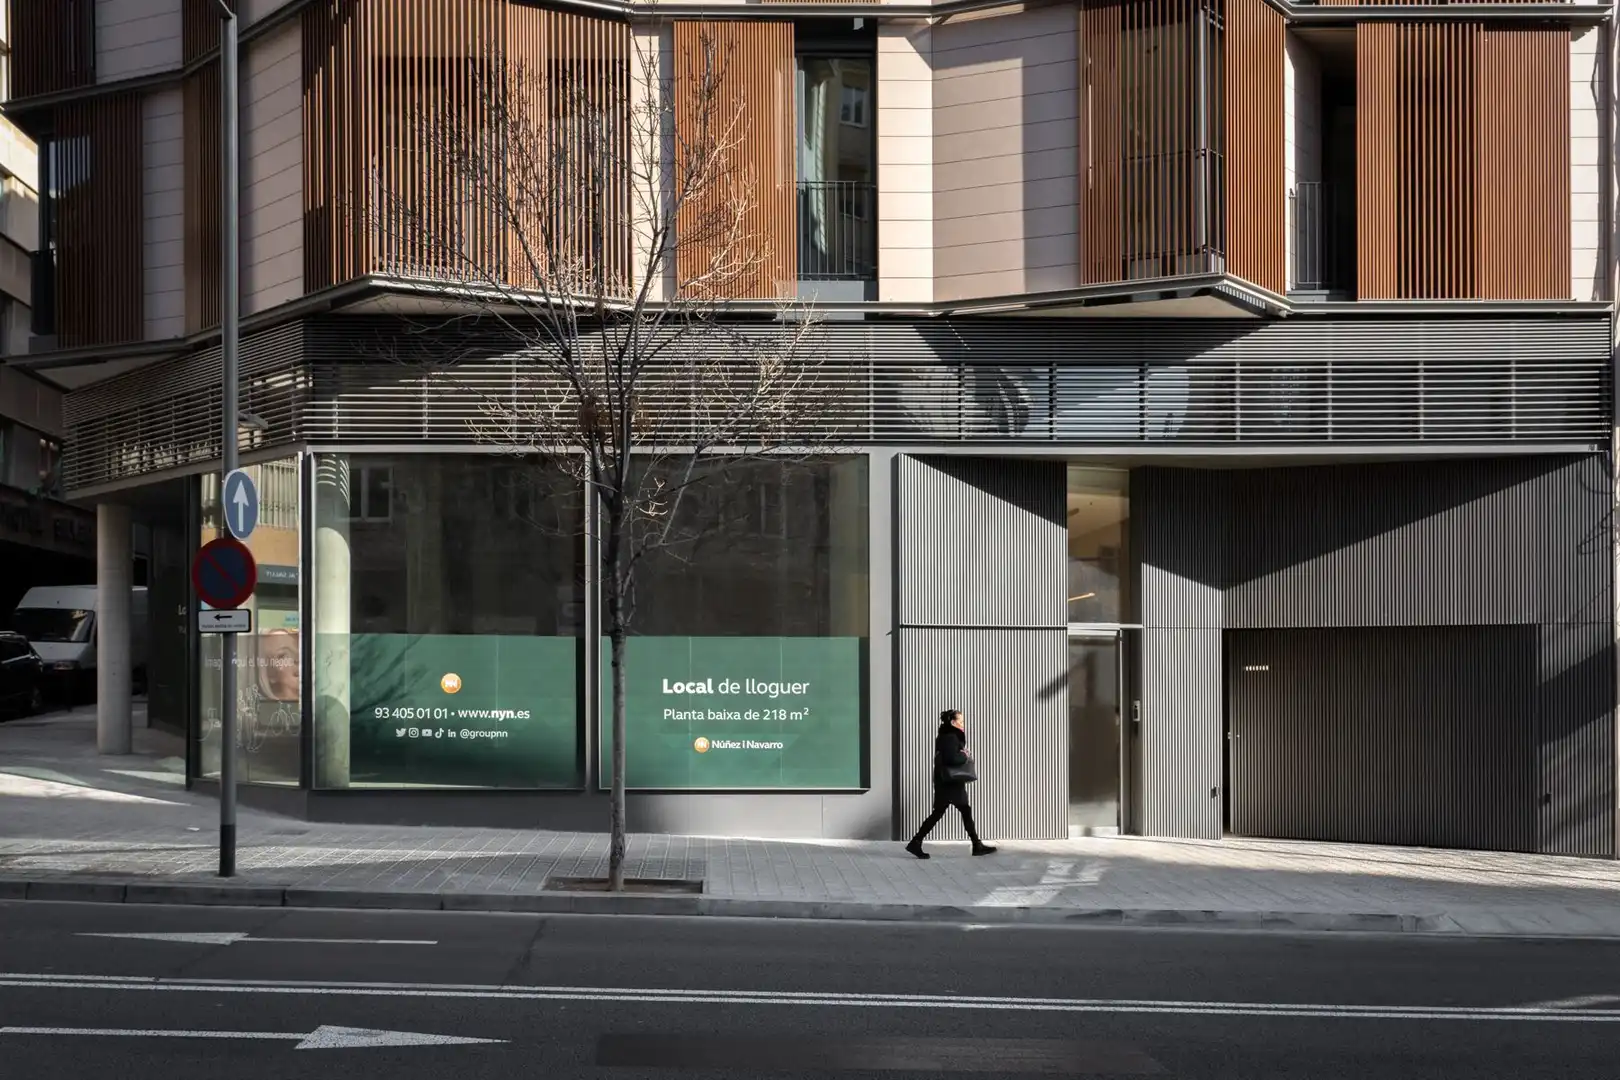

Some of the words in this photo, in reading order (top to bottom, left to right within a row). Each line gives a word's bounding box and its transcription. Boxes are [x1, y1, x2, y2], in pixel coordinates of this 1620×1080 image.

[662, 678, 714, 694] Local
[718, 678, 741, 694] de
[745, 678, 810, 698] lloguer
[374, 707, 390, 719] 93
[392, 707, 414, 719] 405
[416, 707, 430, 719] 01
[433, 707, 448, 719] 01
[457, 708, 530, 721] www.nyn.es
[663, 708, 705, 721] Planta
[707, 708, 741, 721] baixa
[744, 708, 760, 721] de
[763, 708, 787, 721] 218
[459, 728, 508, 740] @groupnn
[711, 739, 741, 749] Núñez
[746, 739, 784, 749] Navarro
